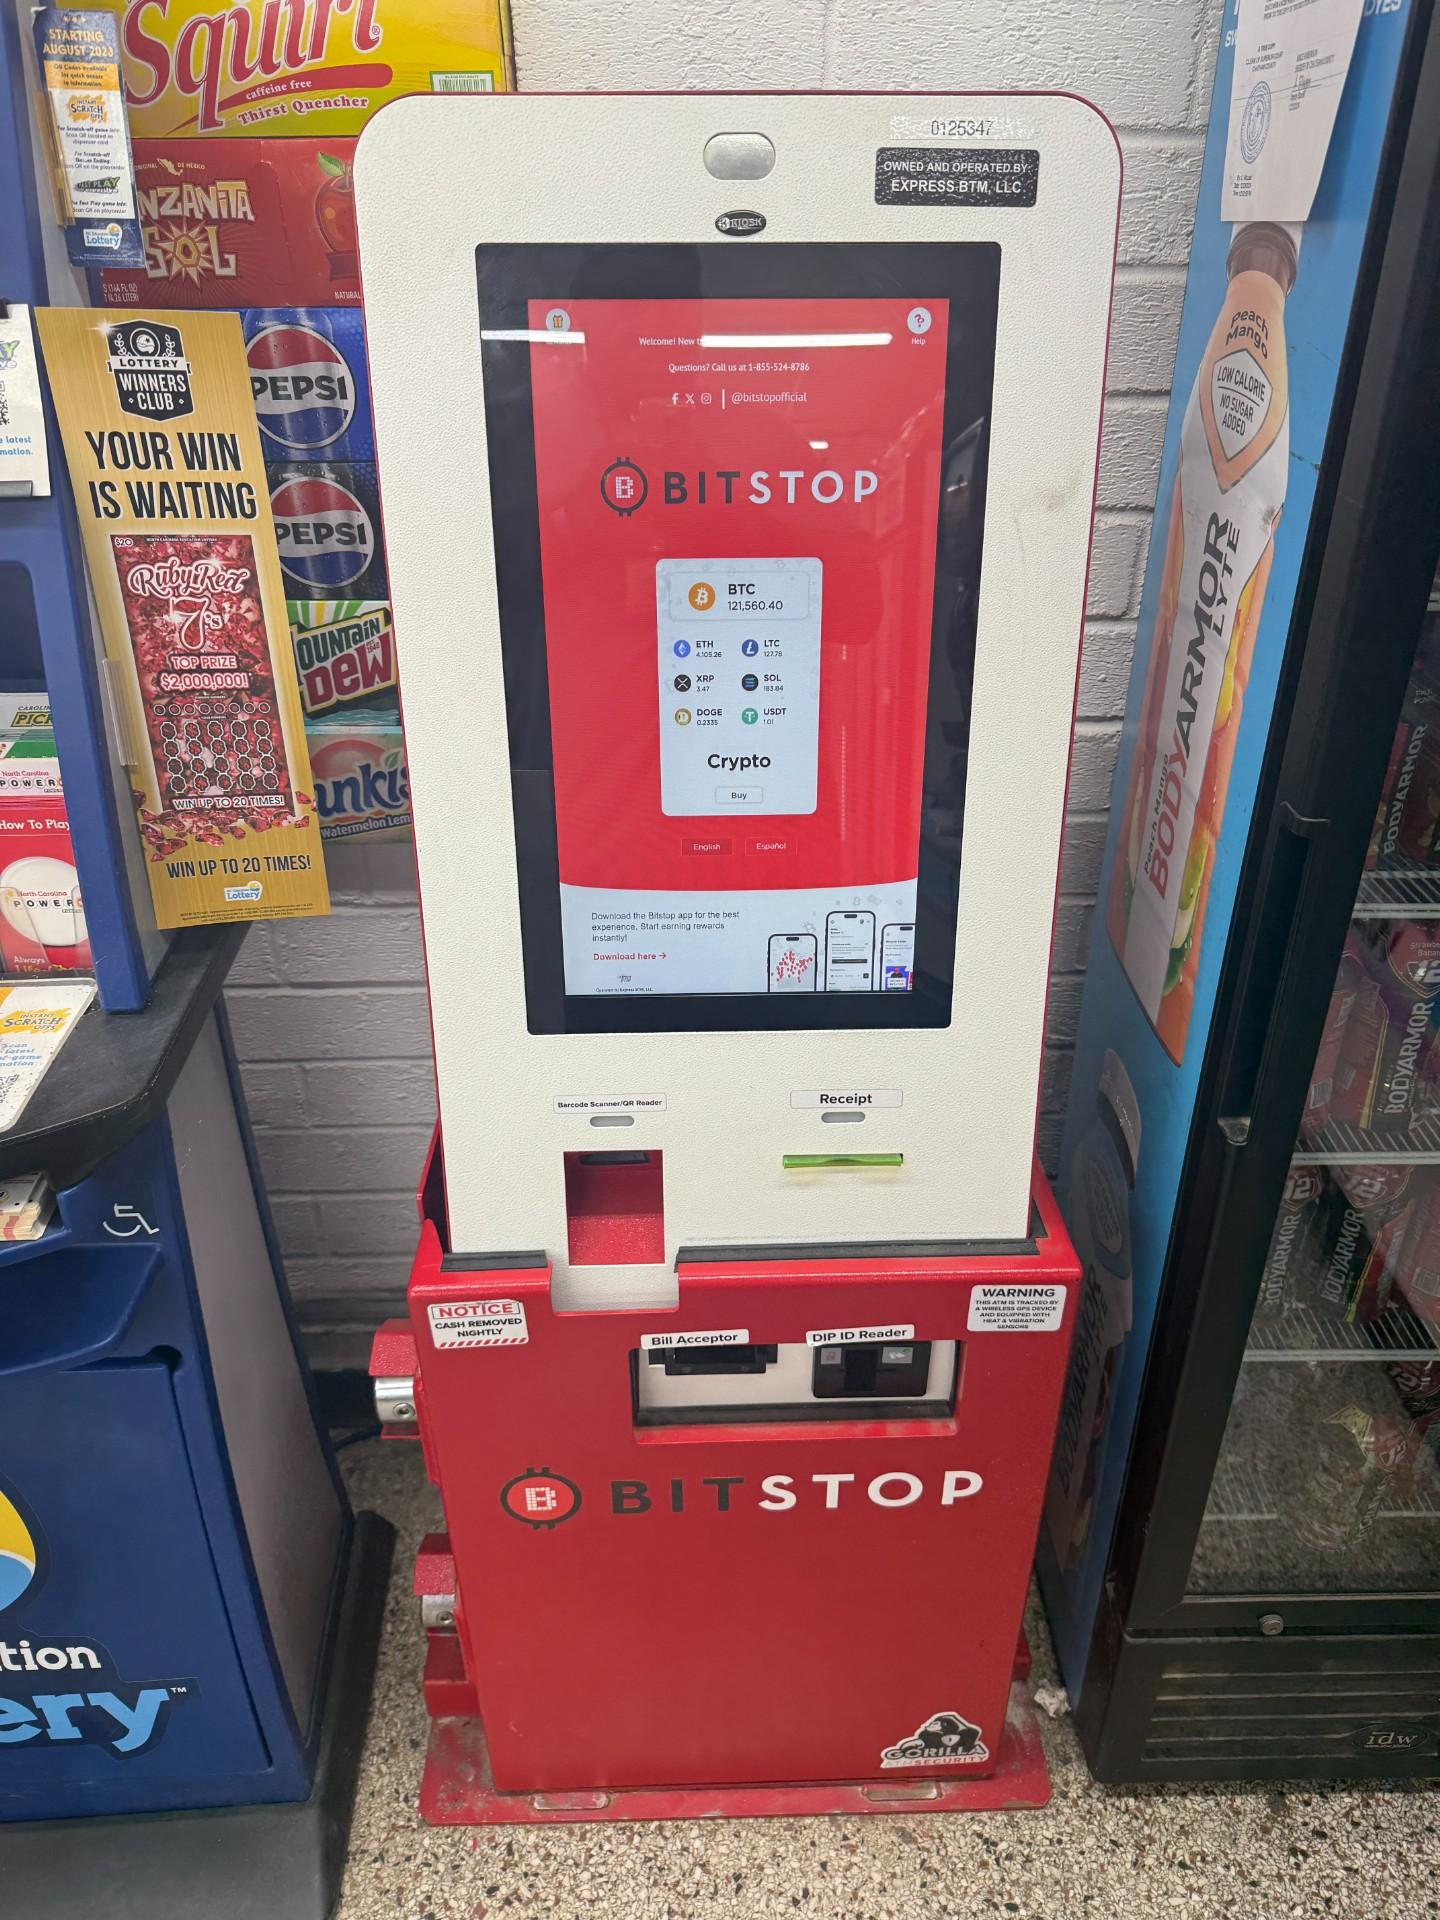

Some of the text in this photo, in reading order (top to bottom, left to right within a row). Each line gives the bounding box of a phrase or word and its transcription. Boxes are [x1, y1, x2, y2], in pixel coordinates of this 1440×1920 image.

[48, 28, 104, 42] STARTING
[43, 43, 86, 55] AUGUST
[246, 78, 312, 101] caffeine free
[238, 95, 369, 125] Thirst Quencher
[931, 120, 993, 136] 0125347
[883, 161, 1028, 173] OWNED AND OPERATED BY
[891, 179, 1021, 194] EXPRESS BTM, LLC
[730, 218, 762, 227] KIOSK
[86, 235, 119, 246] Lottery
[142, 226, 236, 282] SOL
[334, 291, 361, 299] NATURAL
[1231, 311, 1269, 341] Peach
[639, 338, 694, 346] Welcome! New
[911, 336, 926, 346] Help
[1226, 326, 1268, 360] Mango
[119, 357, 179, 369] LOTTERY
[668, 362, 810, 374] Questions? Call us at 1-855-524-8786
[119, 373, 187, 393] WINNERS
[252, 374, 349, 402] PEPSI
[1217, 365, 1266, 401] LOW CALORIE
[137, 391, 174, 411] CLUB
[731, 391, 807, 404] @bitstopofficial
[1219, 393, 1254, 423] NO SUGAR
[1221, 412, 1246, 437] ADDED
[6, 435, 32, 444] latest
[84, 430, 242, 472] YOUR WIN
[663, 470, 879, 504] BITSTOP
[88, 480, 258, 520] IS WAITING
[114, 536, 134, 547] $20
[274, 522, 367, 546] PEPSI
[128, 556, 250, 598] Ruby Red
[1212, 521, 1241, 638] LYTE
[728, 583, 756, 595] BTC
[728, 600, 783, 612] 121,560.40
[170, 596, 224, 650] 7's
[696, 639, 780, 648] ETH LTC
[171, 655, 238, 670] TOP PRIZE
[160, 671, 248, 690] $2,000,000!
[696, 674, 782, 683] XRP SOL
[696, 707, 787, 716] DOGE USDT
[1150, 511, 1228, 899] BODYARMOR
[707, 753, 771, 771] Crypto
[731, 791, 747, 800] Buy
[1383, 723, 1428, 855] BODYARMOR
[173, 796, 285, 810] WIN UP TO 20 TIMES!
[1144, 753, 1169, 874] Peach Mango
[0, 820, 24, 830] How
[27, 819, 42, 830] To
[321, 817, 387, 838] Watermelon
[694, 842, 786, 852] English Español
[166, 854, 312, 879] WIN UP TO 20 TIMES!
[226, 889, 260, 901] Lottery
[591, 911, 740, 921] Download the Bitstop app for the best
[591, 922, 725, 931] experience. Start earning rewards
[14, 955, 45, 964] Always
[593, 952, 656, 961] Download here
[1384, 1002, 1434, 1113] BODYARMOR
[590, 1100, 634, 1108] Scanner/QR
[636, 1098, 662, 1107] Reader
[820, 1092, 872, 1107] Receipt
[1321, 1208, 1365, 1303] BODYARMOR
[982, 1288, 1055, 1297] WARNING
[439, 1303, 513, 1318] NOTICE
[435, 1317, 522, 1330] CASH REMOVED
[457, 1328, 504, 1337] NIGHTLY
[651, 1332, 738, 1345] Bill Acceptor
[812, 1327, 908, 1343] DIP ID Reader
[610, 1470, 984, 1514] BITSTOP
[0, 1640, 102, 1671] tion
[1366, 1731, 1418, 1745] idw
[884, 1743, 987, 1760] GORILLA
